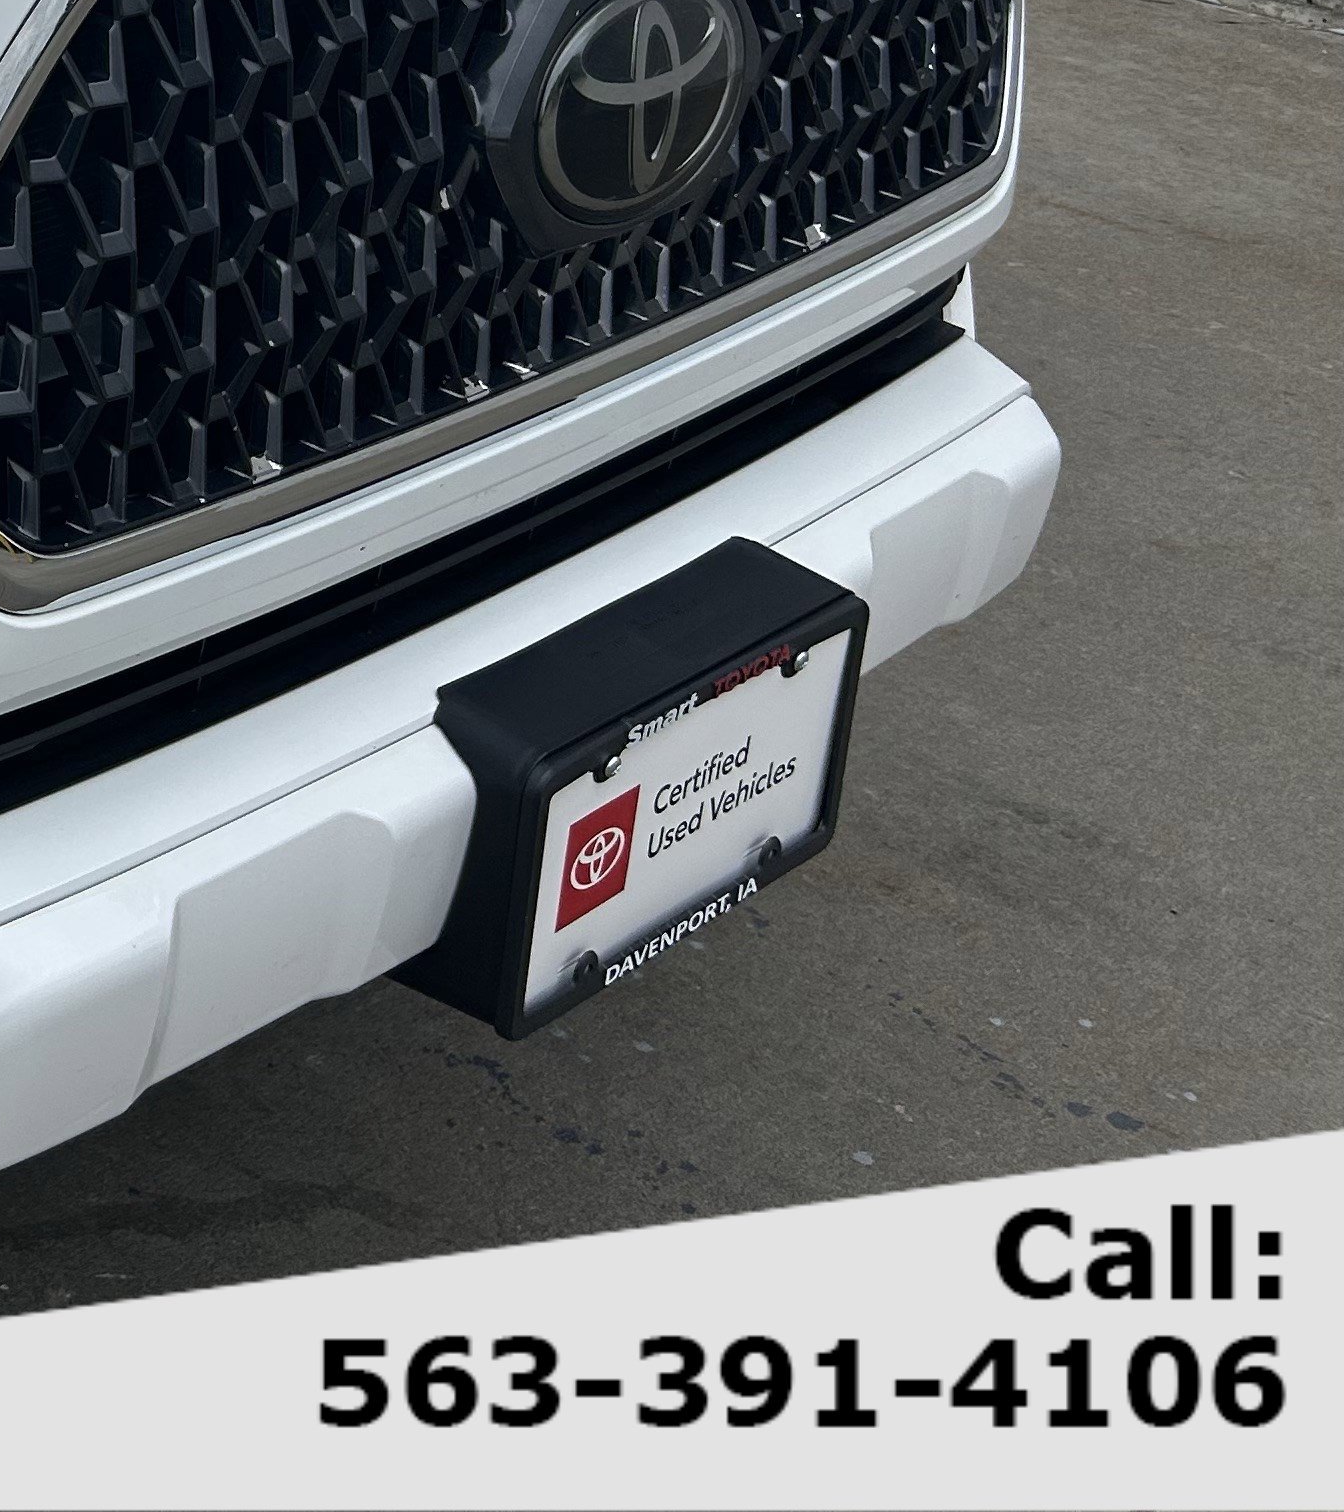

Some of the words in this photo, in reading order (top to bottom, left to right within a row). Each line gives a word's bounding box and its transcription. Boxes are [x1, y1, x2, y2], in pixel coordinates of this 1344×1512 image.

[626, 692, 698, 749] Smart
[714, 644, 790, 698] TOYOTA
[646, 804, 702, 860] Used
[709, 755, 797, 822] Vehicles
[653, 738, 751, 815] Certified
[604, 894, 732, 986] DAVENPORT,
[737, 877, 758, 901] IA
